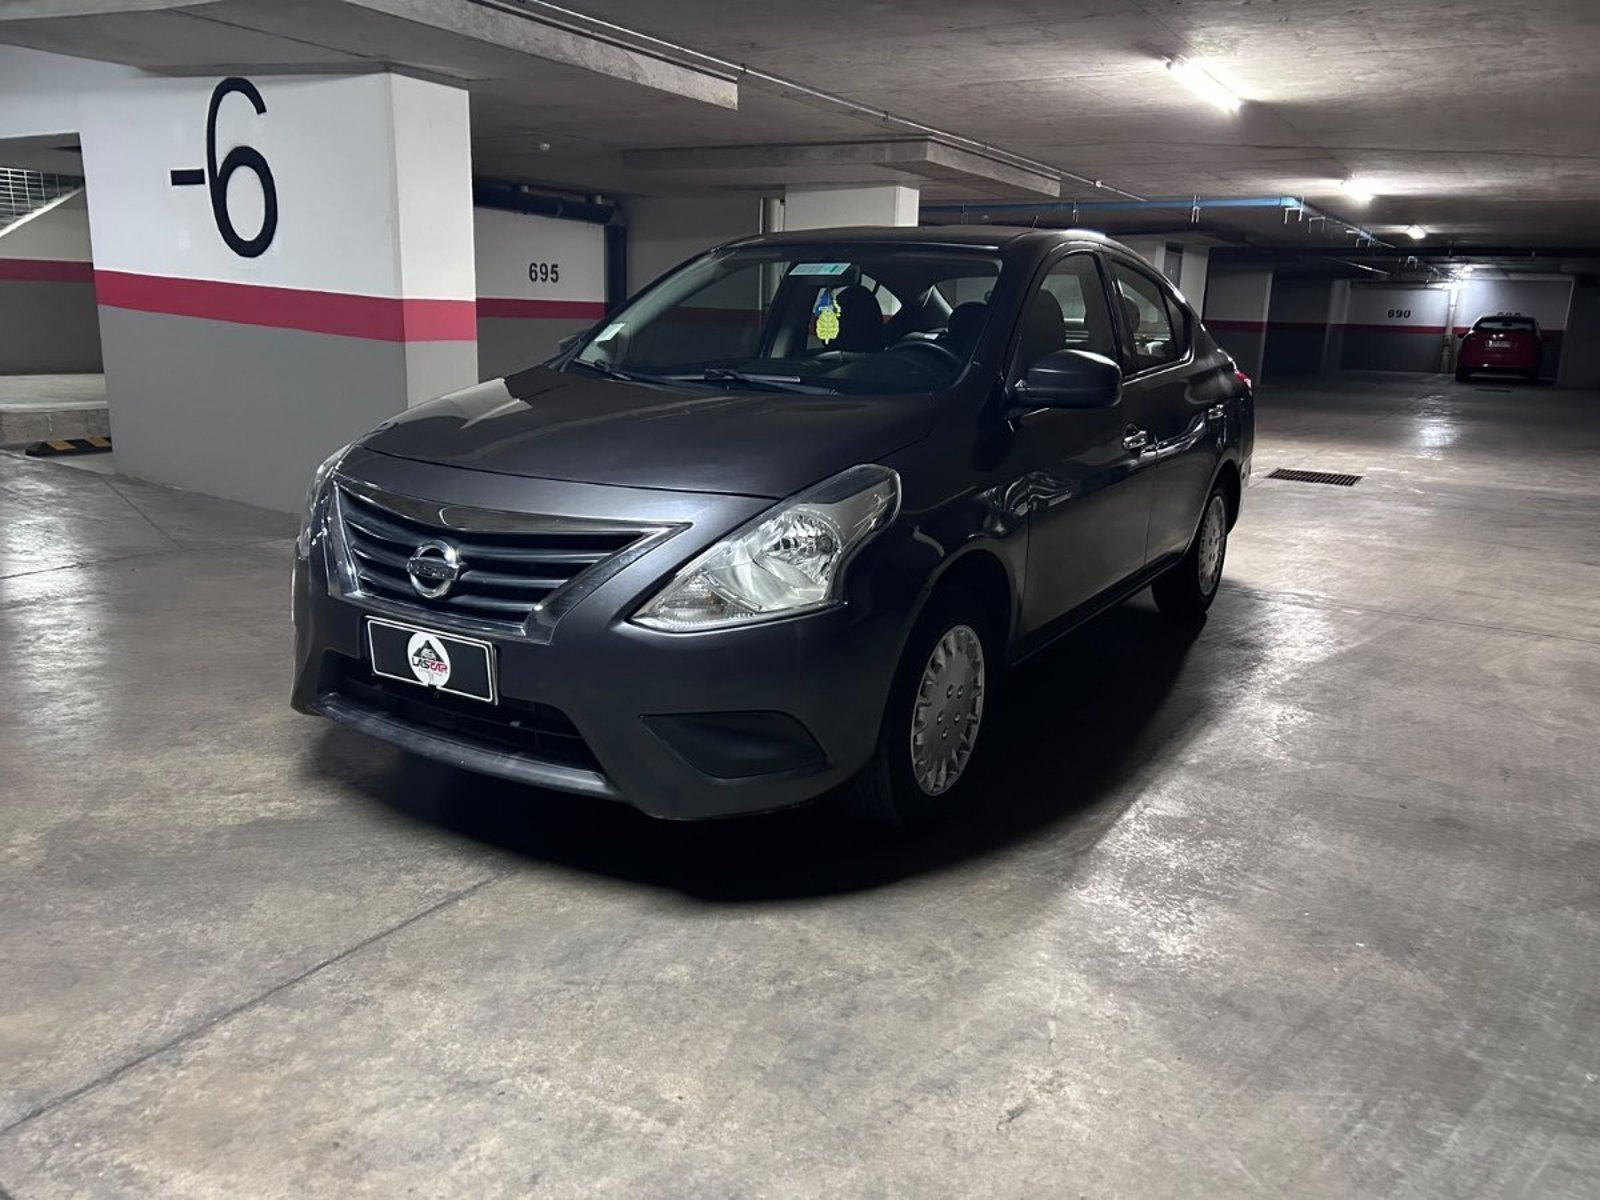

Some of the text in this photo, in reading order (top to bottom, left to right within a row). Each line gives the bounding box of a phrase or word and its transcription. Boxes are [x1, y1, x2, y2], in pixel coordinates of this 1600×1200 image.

[170, 76, 278, 258] -6
[529, 262, 559, 283] 695
[1387, 309, 1411, 319] 690
